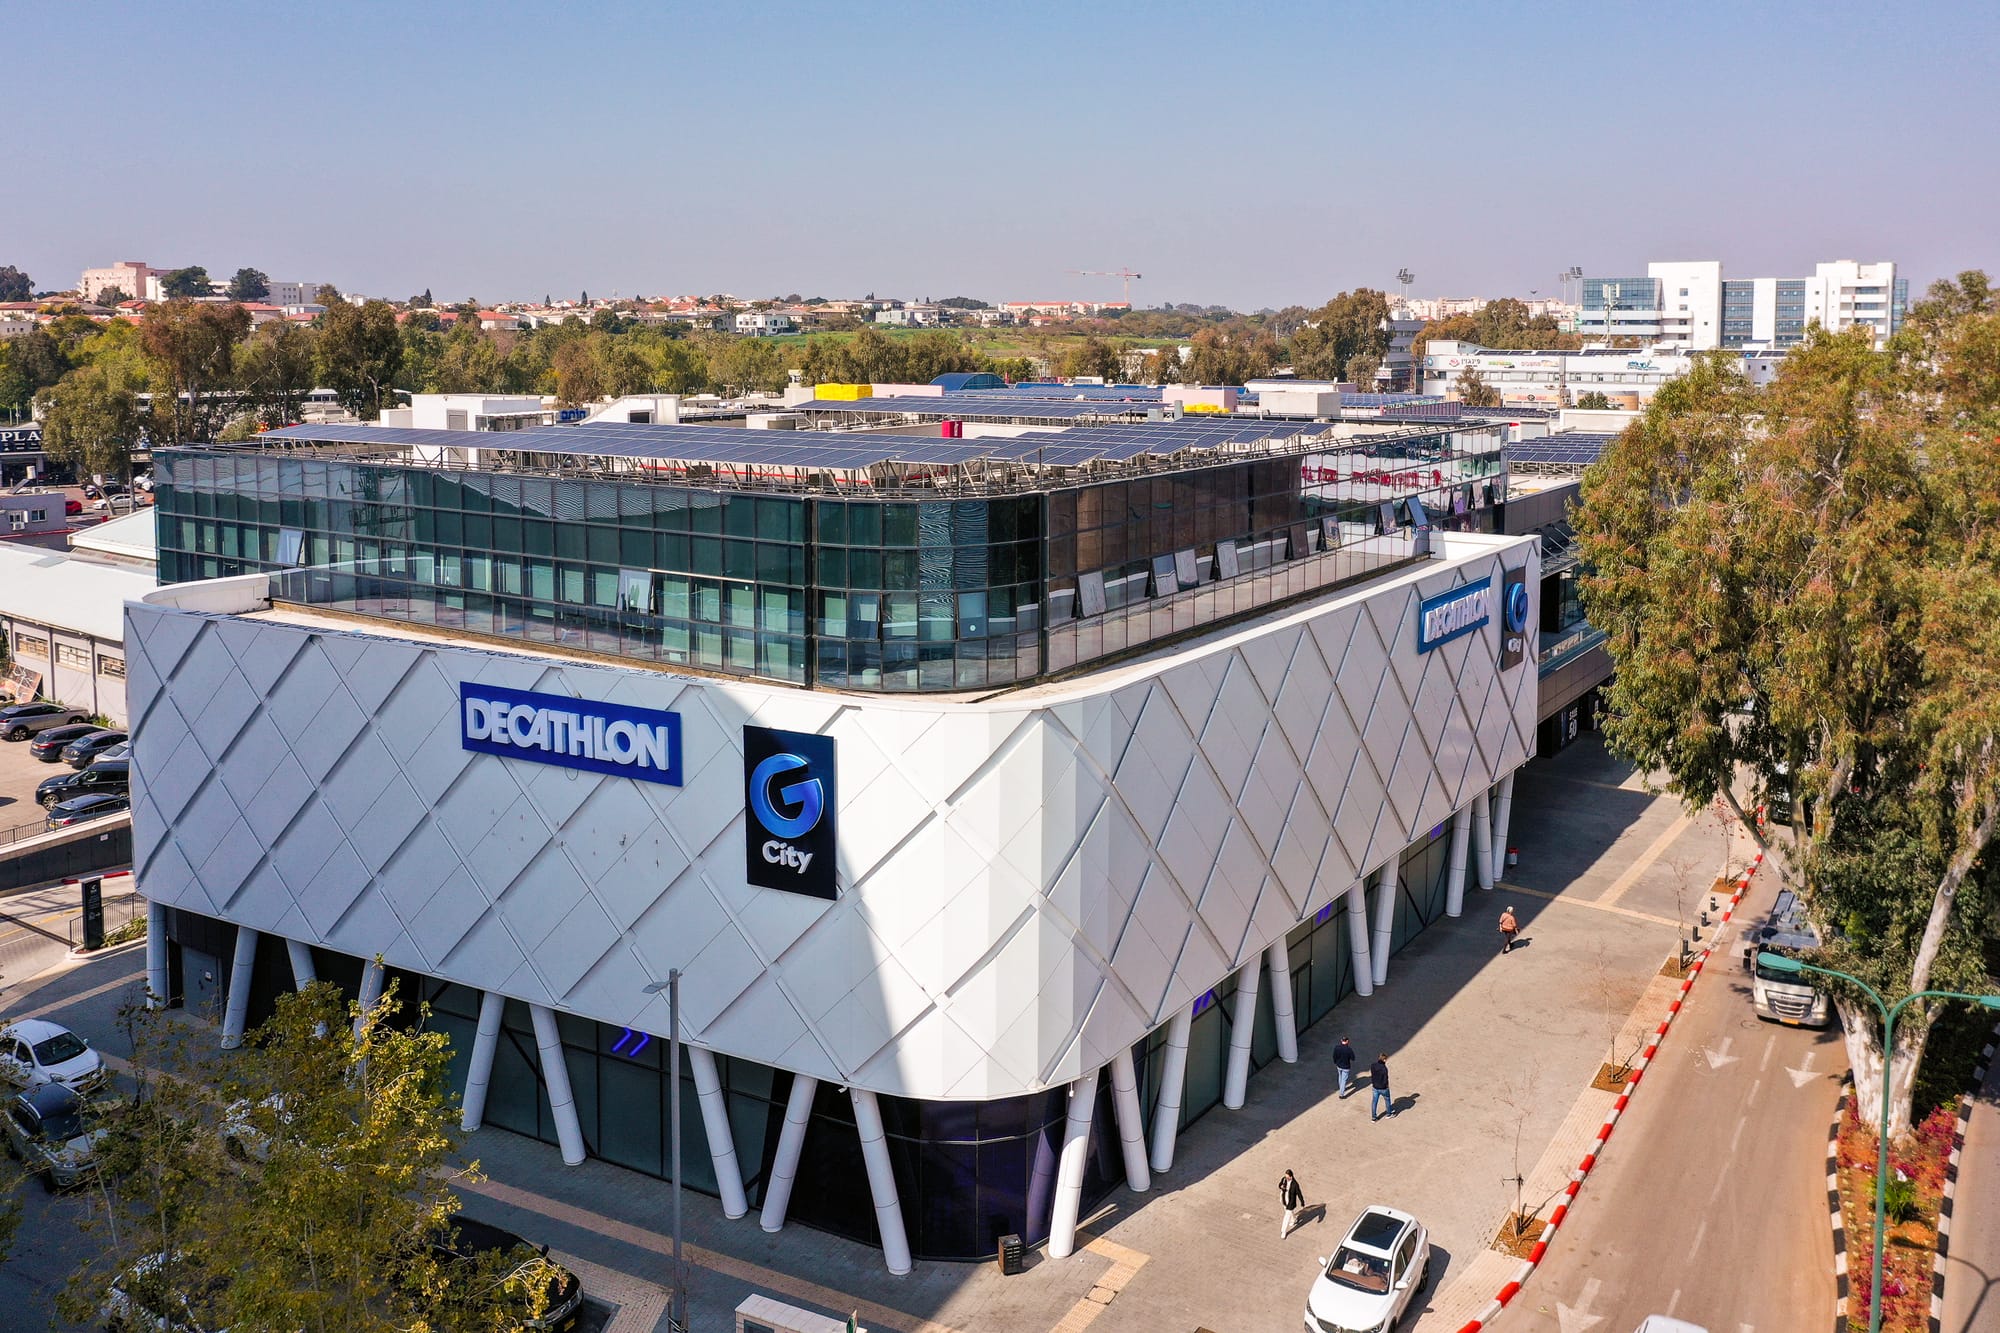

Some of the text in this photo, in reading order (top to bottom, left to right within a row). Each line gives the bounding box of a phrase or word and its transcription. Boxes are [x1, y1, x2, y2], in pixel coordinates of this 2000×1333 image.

[1, 431, 42, 442] PLA
[1423, 587, 1491, 644] DECATHLON
[465, 696, 670, 772] DECATHLON
[749, 752, 824, 840] G
[762, 840, 815, 875] City
